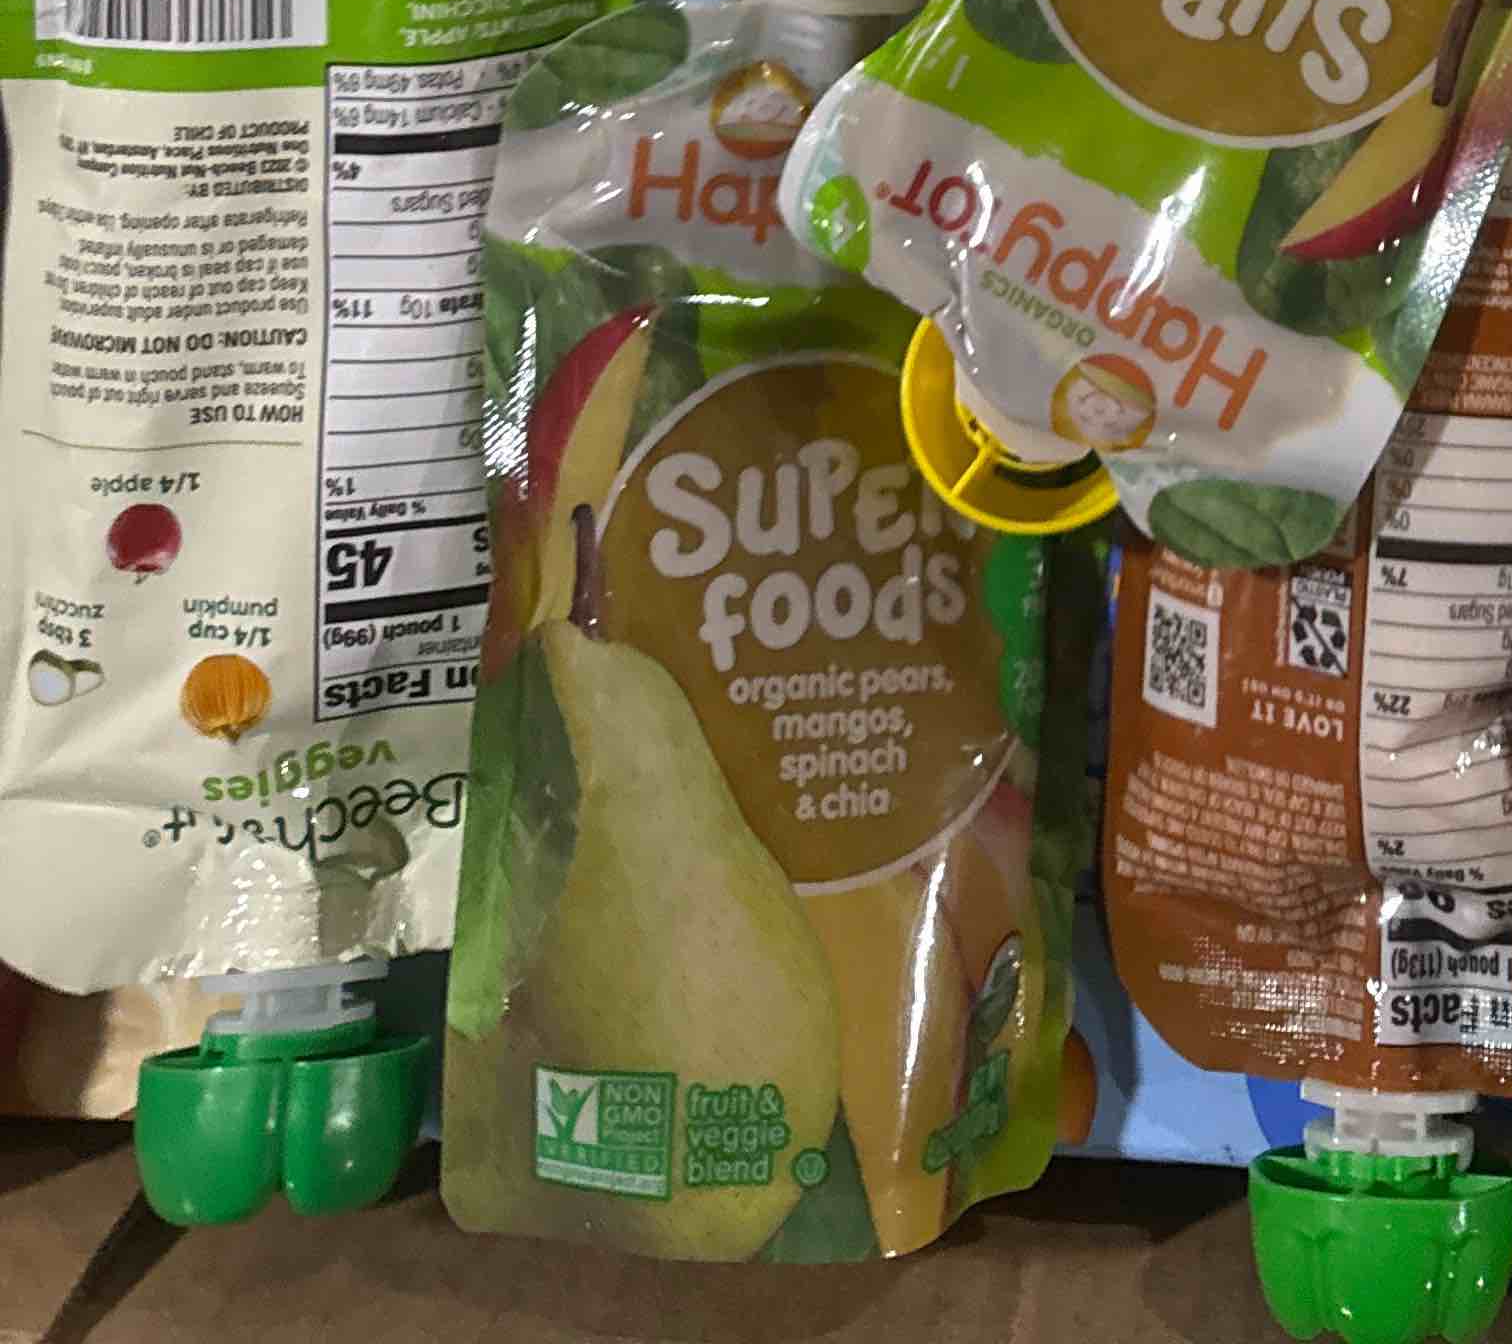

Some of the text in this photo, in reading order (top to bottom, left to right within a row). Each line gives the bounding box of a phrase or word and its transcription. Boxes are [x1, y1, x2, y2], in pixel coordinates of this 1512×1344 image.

[978, 269, 1098, 350] ORGANICS
[140, 325, 306, 352] CAUTION: DO NOT
[325, 539, 392, 590] 45
[182, 596, 278, 619] pumpkin
[188, 619, 271, 647] 1/4 cup
[323, 667, 430, 711] Facts
[727, 664, 954, 711] organic pears,
[773, 701, 914, 749] mangos,
[778, 739, 907, 786] spinach
